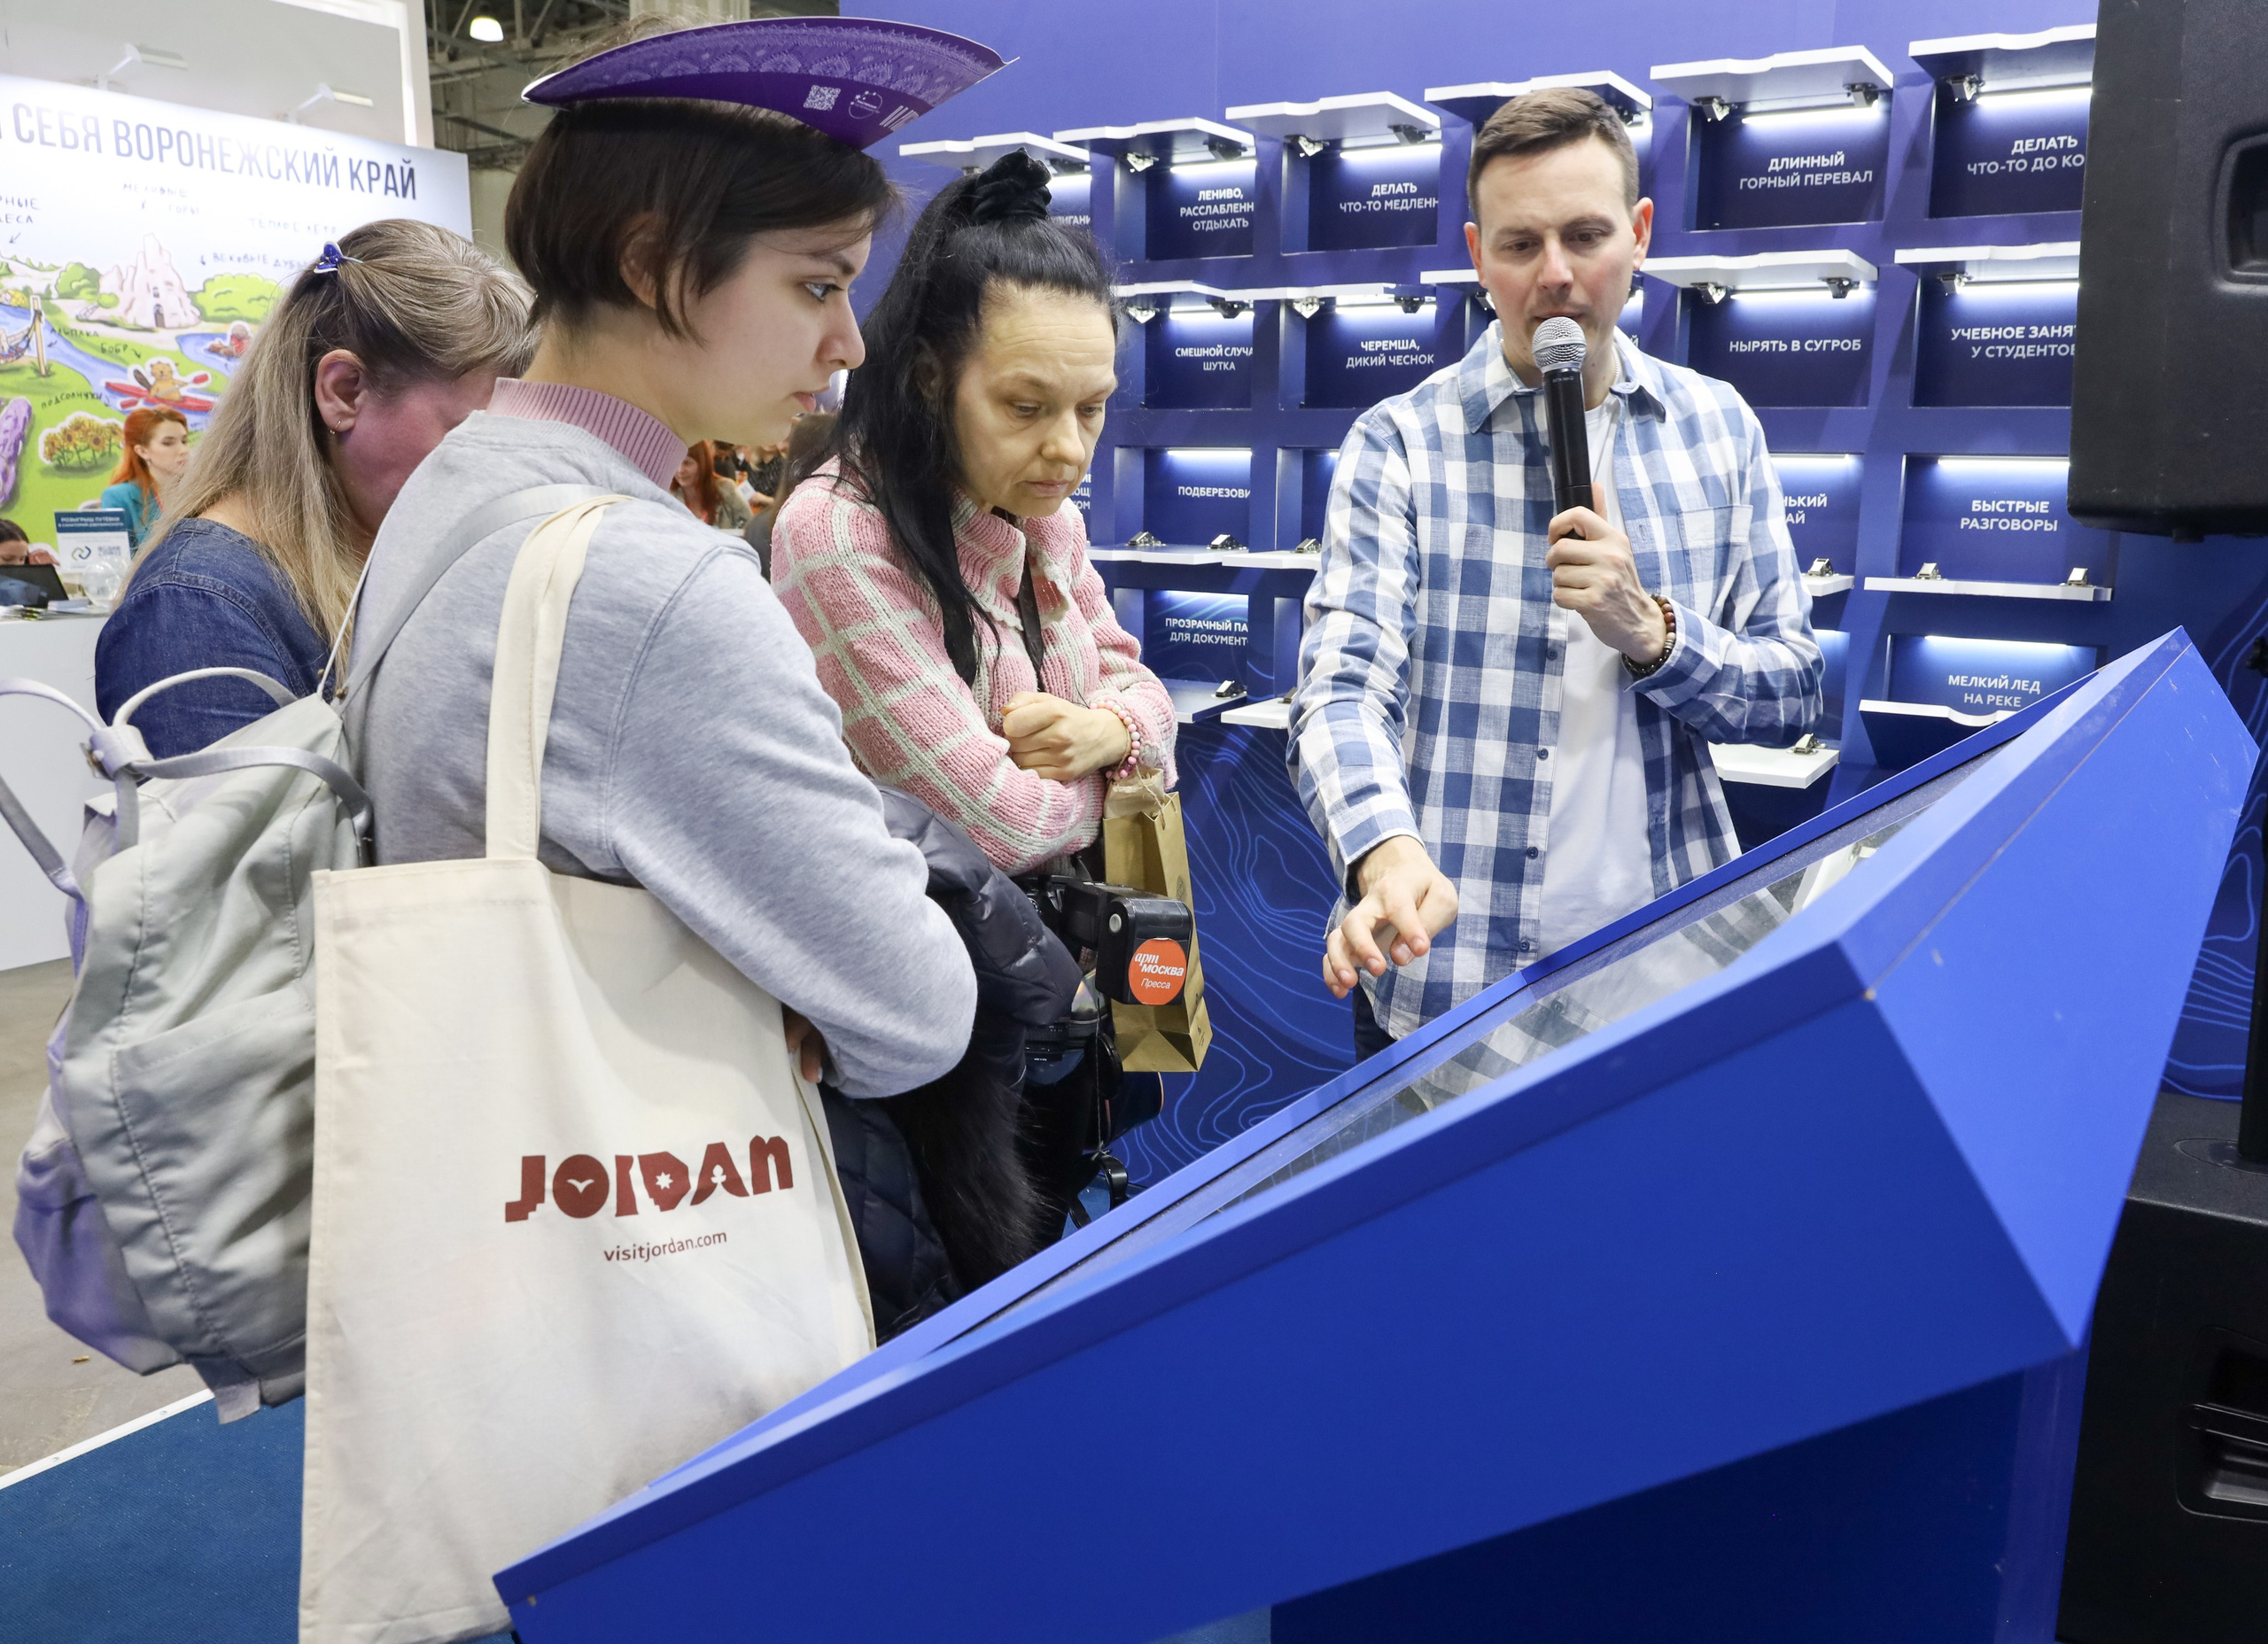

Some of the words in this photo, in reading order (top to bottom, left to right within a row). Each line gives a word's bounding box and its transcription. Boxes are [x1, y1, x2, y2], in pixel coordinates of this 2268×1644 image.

[12, 102, 103, 154] СЕБЯ
[113, 119, 340, 189] ВОРОНЕЖСКИЙ
[349, 158, 416, 200] КРАЙ
[2011, 136, 2078, 155] ДЕЛАТЬ
[1768, 151, 1845, 172] ДЛИННЫЙ
[1968, 159, 2028, 175] ЧТО-ТО
[2031, 156, 2057, 173] ДО
[2062, 153, 2085, 167] КО
[1739, 172, 1800, 190] ГОРНЫЙ
[1804, 170, 1873, 186] ПЕРЕВАЛ
[1198, 187, 1243, 201] ЛЕНИВО,
[1371, 182, 1418, 198] ДЕЛАТЬ
[1180, 202, 1254, 217] РАССЛАБЛЕНН
[1340, 200, 1381, 213] ЧТО-ТО
[0, 213, 34, 223] ЕСА
[1192, 218, 1249, 231] ОТДЫХАТЬ
[1951, 326, 2025, 340] УЧЕБНОЕ
[2029, 325, 2077, 338] ЗАНЯ
[100, 343, 128, 353] БОБР
[1175, 345, 1223, 357] СМЕШНОЙ
[1224, 346, 1253, 357] СЛУЧА
[1360, 338, 1420, 351] ЧЕРЕМША,
[1729, 340, 1788, 352] НЫРЯТЬ
[1791, 340, 1800, 352] В
[1805, 339, 1861, 352] СУГРОБ
[1971, 346, 1982, 358] У
[1203, 361, 1236, 370] ШУТКА
[1346, 353, 1386, 368] ДИКИЙ
[1388, 354, 1434, 366] ЧЕСНОК
[1177, 485, 1251, 498] ПОДБЕРЕЗОВИ
[1971, 500, 2050, 513] БЫСТРЫЕ
[1961, 517, 2058, 531] РАЗГОВОРЫ
[1165, 618, 1232, 632] ПРОЗРАЧНЫЙ
[1234, 623, 1248, 632] ПА
[1170, 632, 1191, 642] ДЛЯ
[1192, 633, 1248, 646] ДОКУМЕНТ
[1948, 675, 2008, 689] МЕЛКИЙ
[2010, 679, 2040, 694] ЛЕД
[1963, 693, 1984, 704] НА
[1986, 694, 2022, 708] РЕКЕ
[1140, 978, 1170, 989] Пресса
[604, 1231, 727, 1262] visitjordan.com
